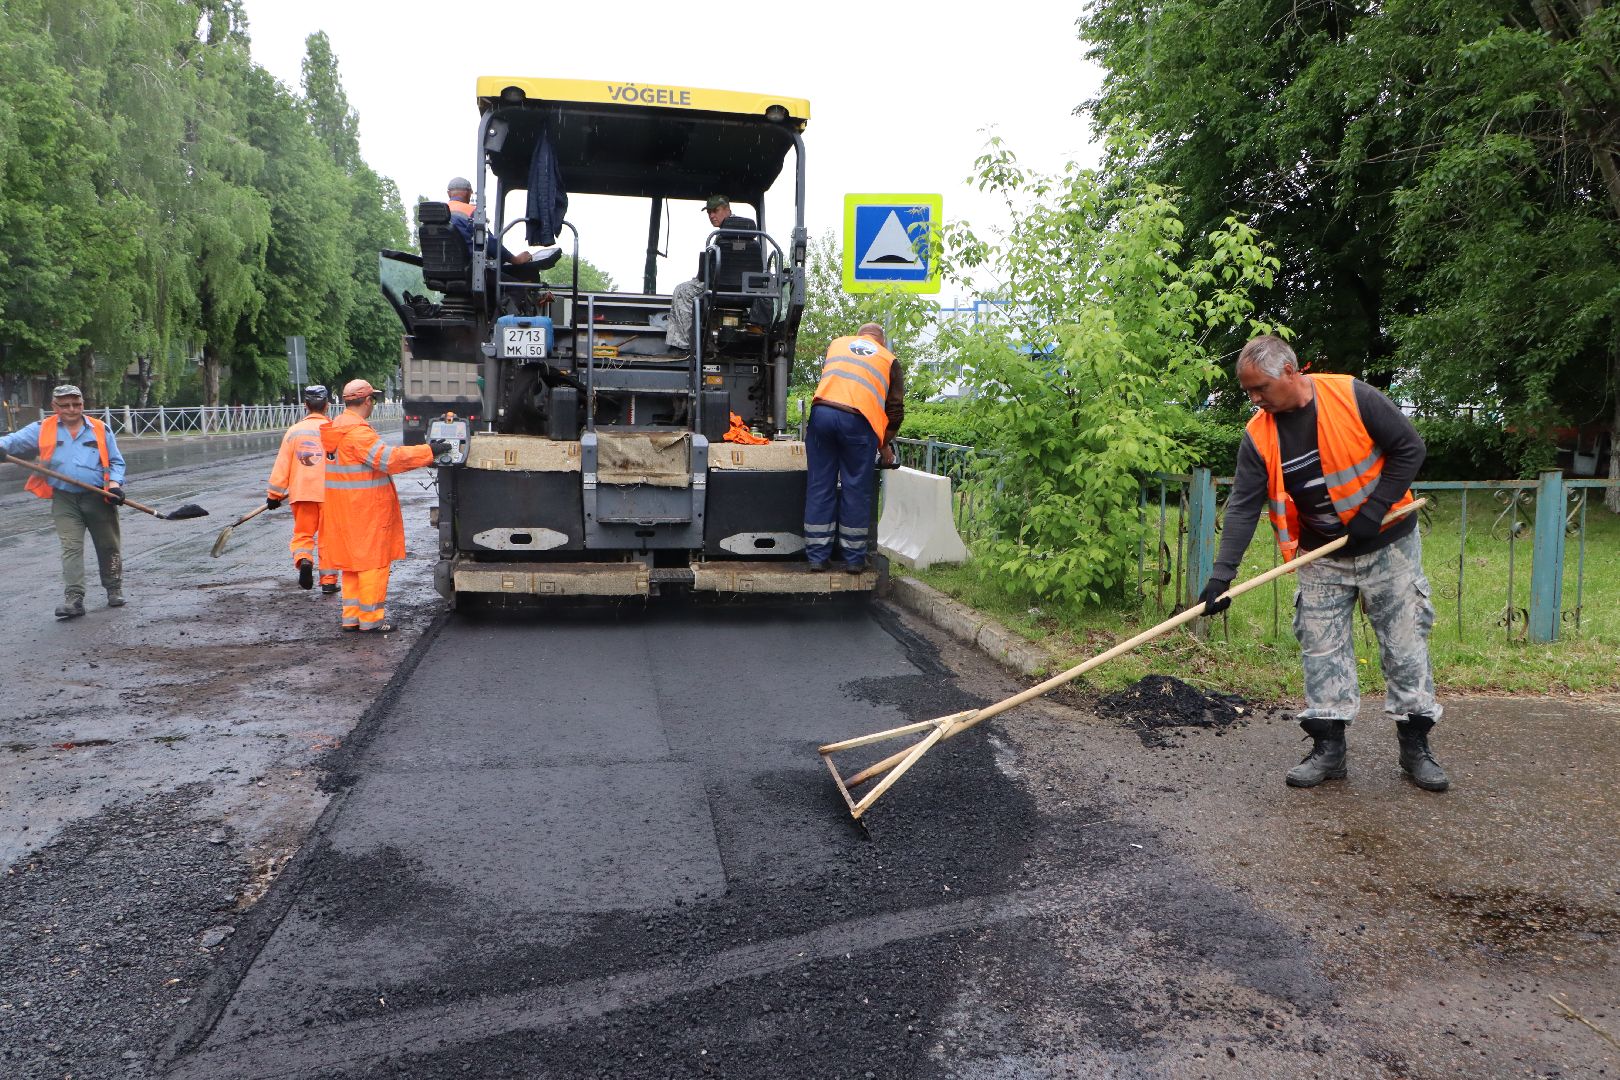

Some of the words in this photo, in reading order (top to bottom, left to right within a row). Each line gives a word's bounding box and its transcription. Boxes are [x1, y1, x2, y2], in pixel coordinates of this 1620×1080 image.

[608, 82, 691, 105] VÖGELE
[509, 330, 541, 342] 2713
[530, 346, 542, 356] 50
